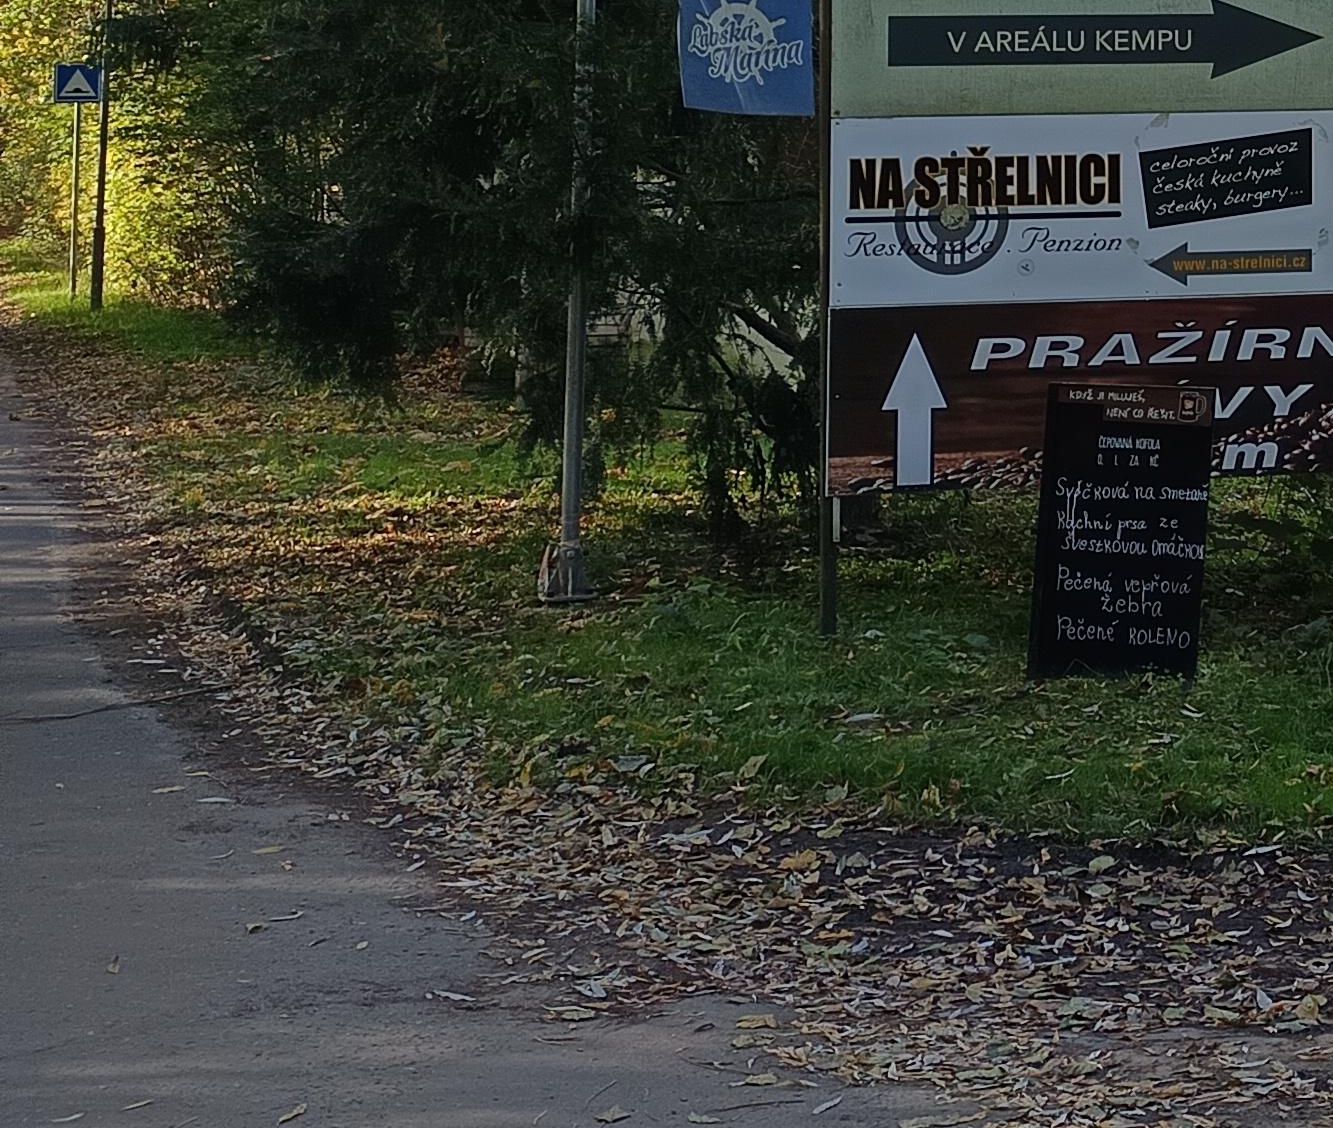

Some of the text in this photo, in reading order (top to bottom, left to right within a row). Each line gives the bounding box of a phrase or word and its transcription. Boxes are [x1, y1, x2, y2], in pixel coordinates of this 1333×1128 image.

[947, 25, 1193, 52] V AREÁLU KEMPU
[1149, 141, 1299, 173] celoroční provoz
[848, 145, 1121, 210] NA STŘELNICI
[1152, 160, 1284, 195] česká kuchyně
[1155, 194, 1217, 216] steaky,
[844, 226, 1122, 257] Restaurace Penzion
[1172, 254, 1306, 272] www.na-strelnici.cz
[1134, 486, 1156, 500] na
[1159, 516, 1179, 529] ze
[1056, 614, 1191, 649] Pečené KOLENO
